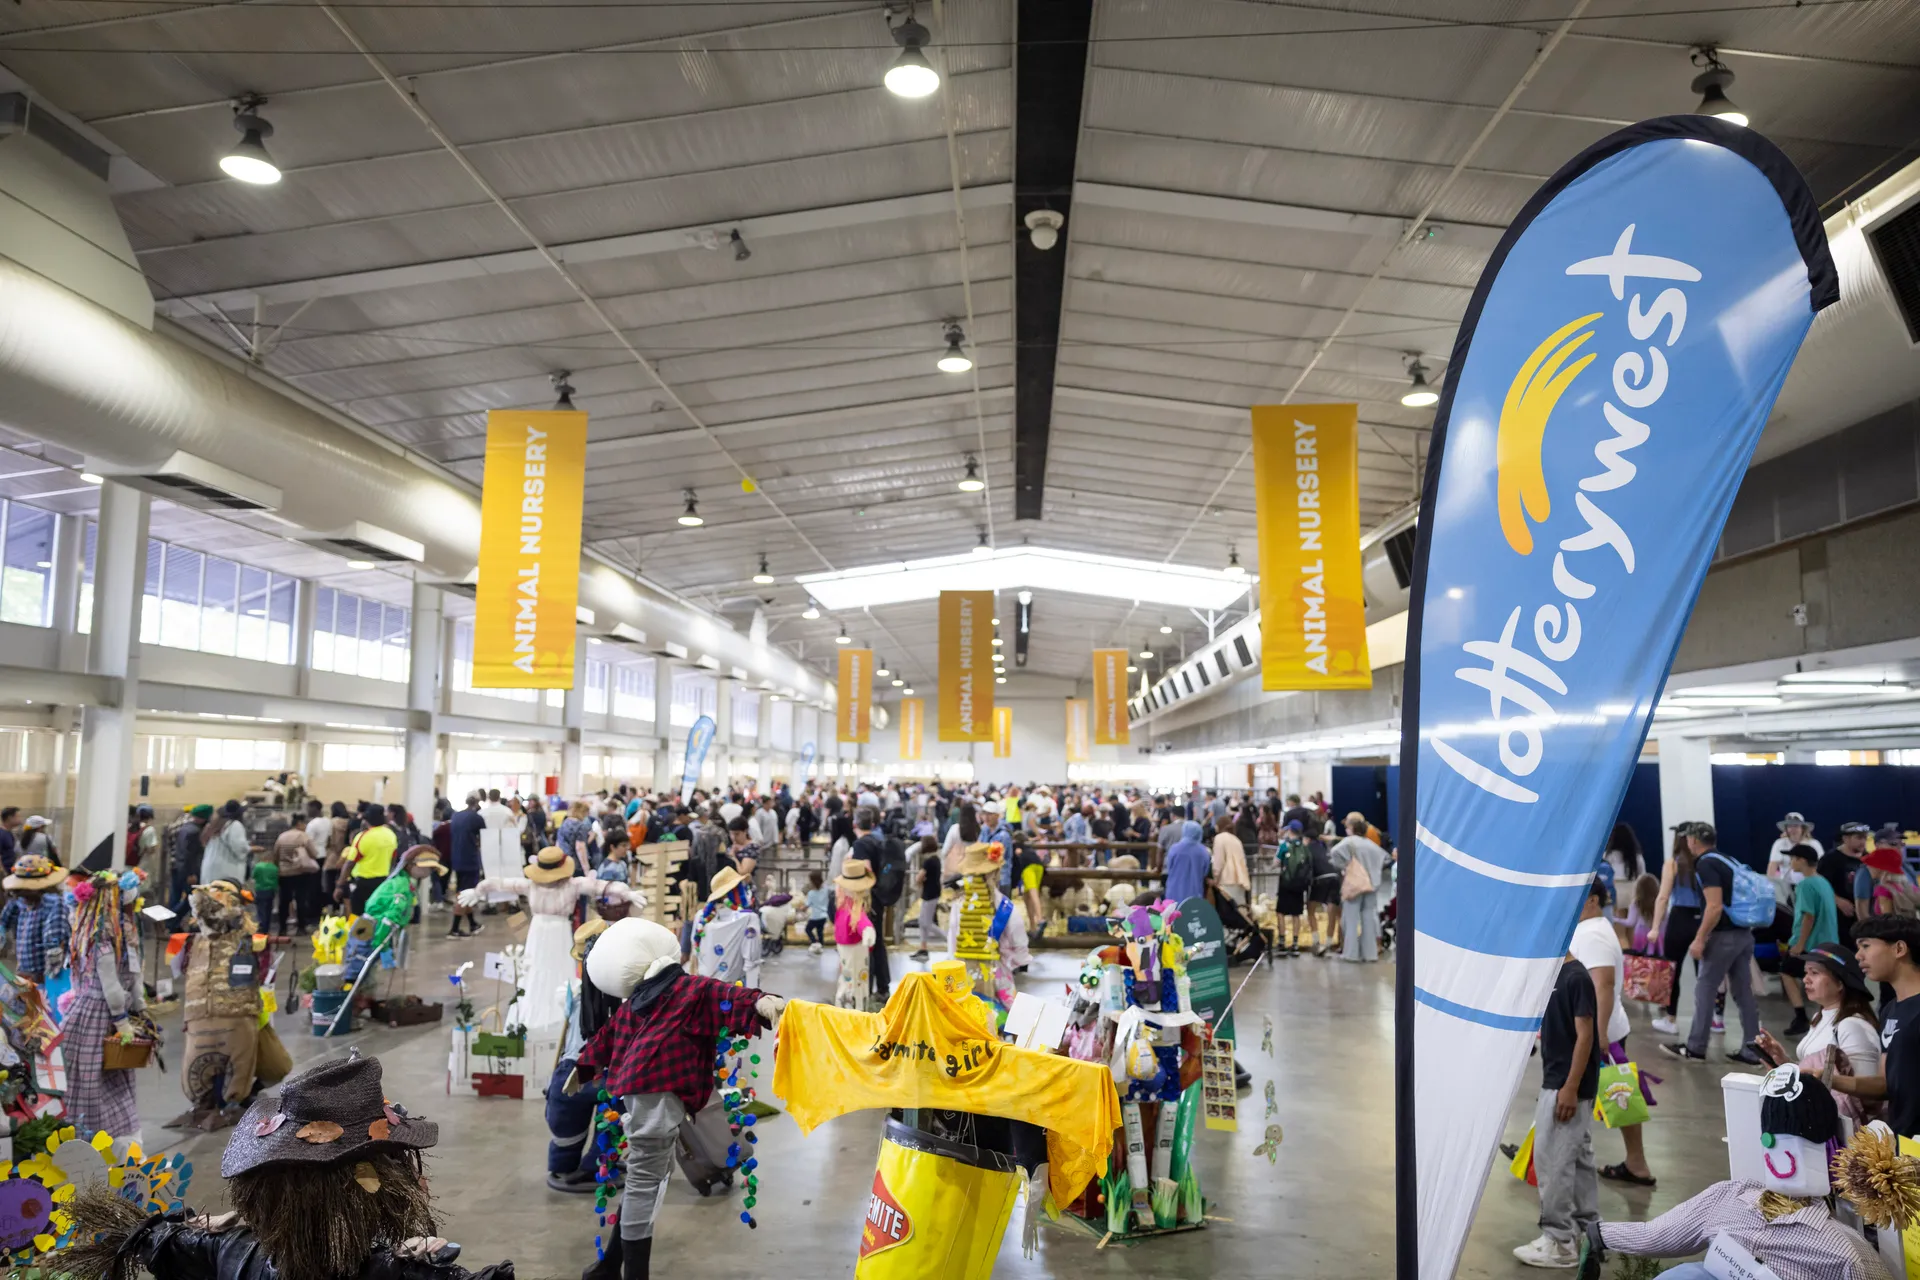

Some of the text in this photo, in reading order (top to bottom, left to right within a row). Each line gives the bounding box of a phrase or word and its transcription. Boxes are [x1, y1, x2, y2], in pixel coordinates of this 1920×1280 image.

[512, 425, 548, 674] ANIMAL NURSERY
[1294, 419, 1328, 675] ANIMAL NURSERY
[1430, 223, 1702, 804] lotterywest
[960, 597, 973, 735] ANIMAL NURSERY
[1714, 1245, 1746, 1276] Hocking
